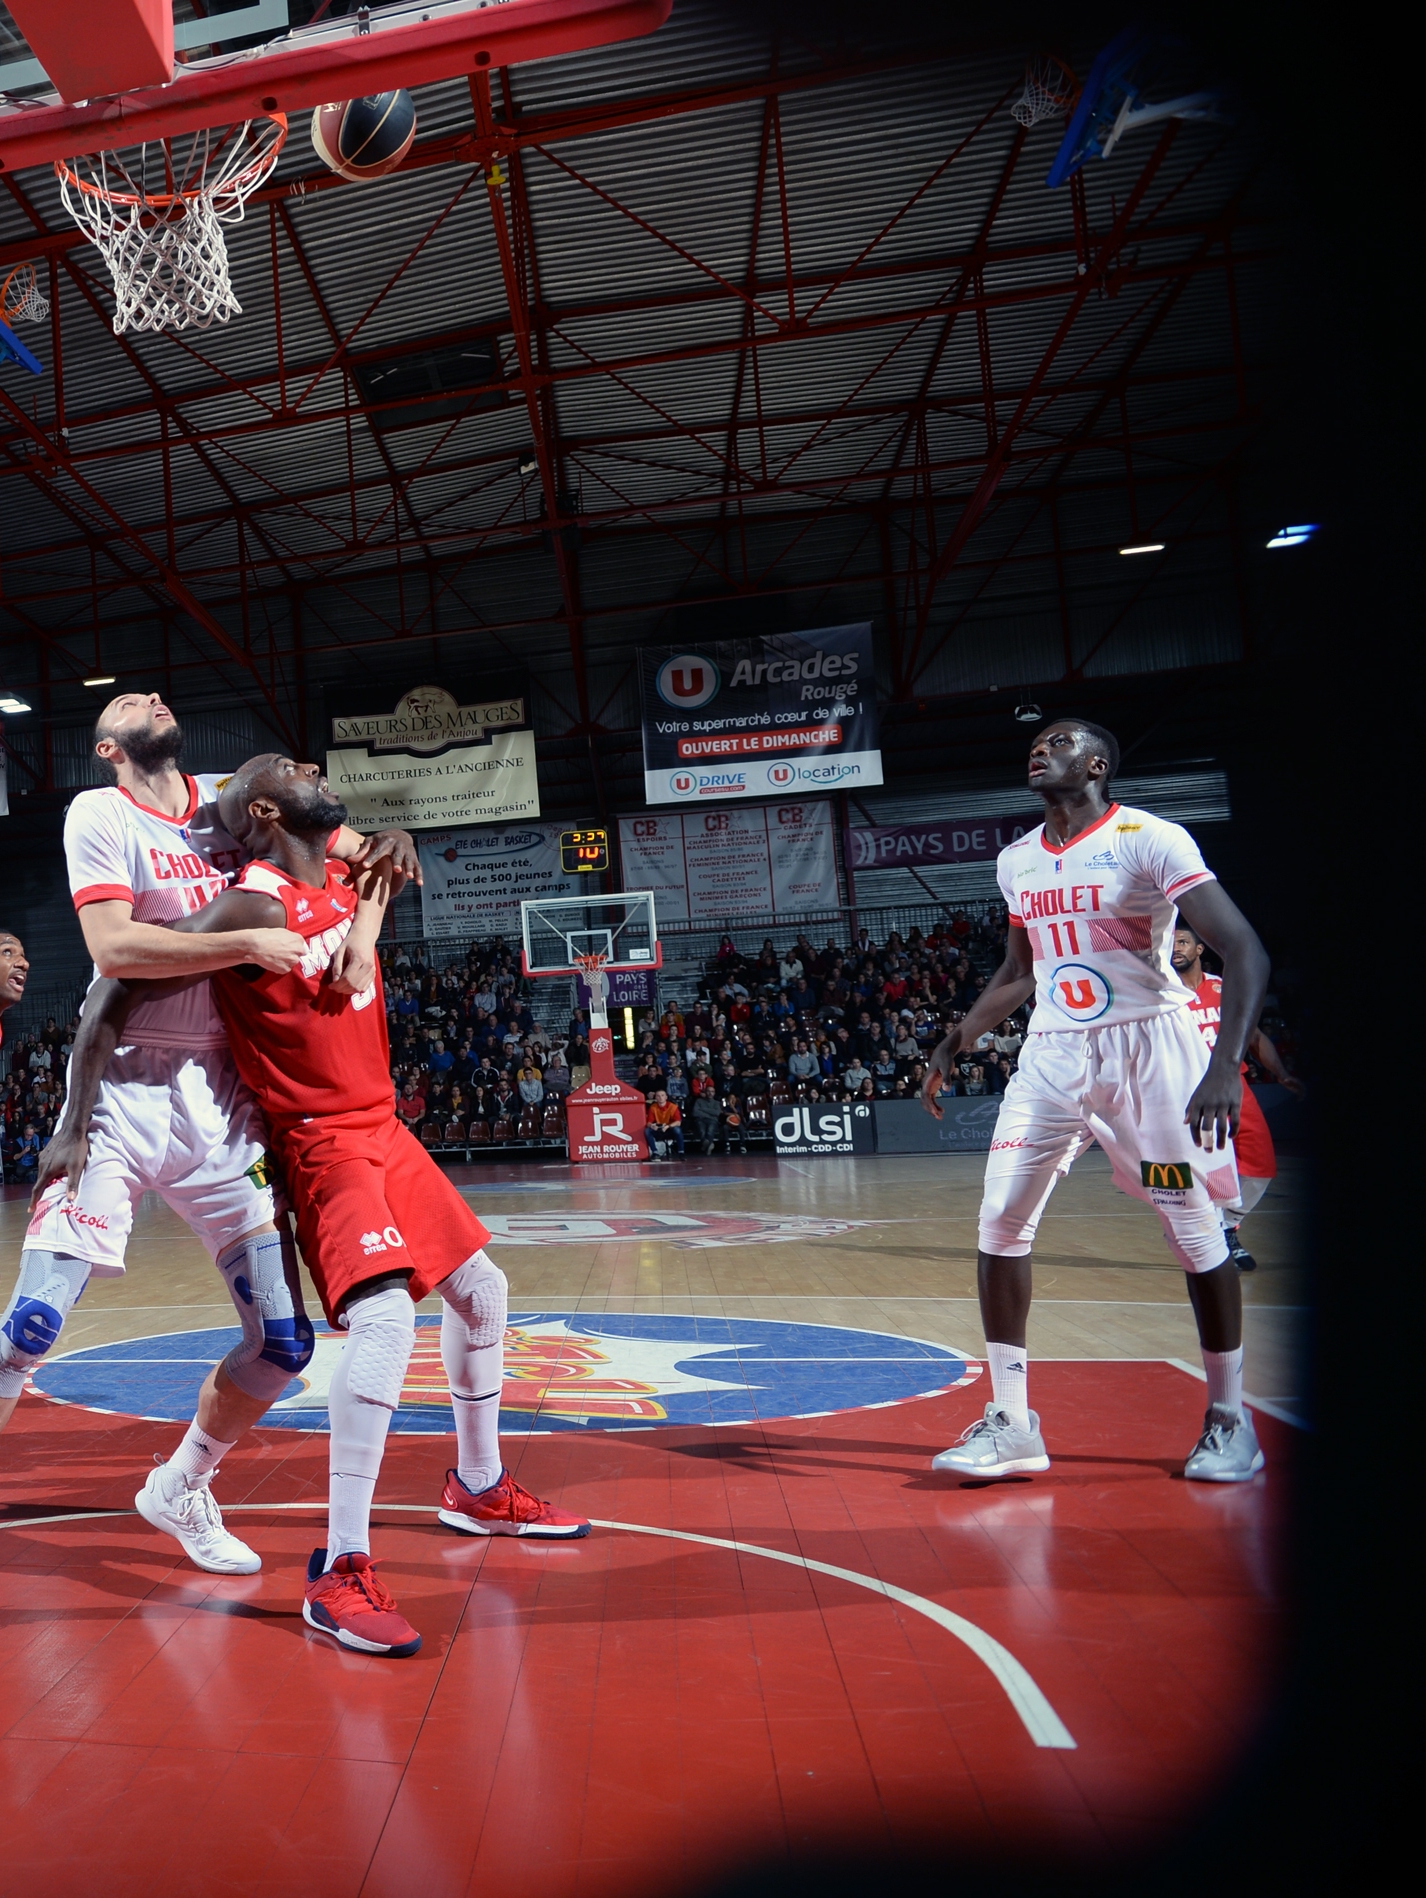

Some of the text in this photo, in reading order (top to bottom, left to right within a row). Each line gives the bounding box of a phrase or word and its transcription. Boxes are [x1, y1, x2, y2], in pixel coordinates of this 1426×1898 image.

[729, 650, 859, 687] Arcades
[801, 680, 857, 701] Rougé
[337, 702, 520, 738] SAVEURS DES MAUGES
[656, 721, 689, 733] Votre
[693, 712, 771, 732] supermarché
[813, 706, 829, 719] de
[833, 704, 854, 716] ville
[379, 728, 478, 745] traditions de l'Anjou
[682, 730, 838, 754] OUVERT LE DIMANCHE
[340, 757, 523, 783] CHARCUTERIES A L'ANCIENNE
[798, 763, 860, 780] location
[699, 773, 746, 786] DRIVE
[381, 795, 405, 807] Aux
[409, 796, 448, 810] rayons
[452, 789, 495, 801] traiteur
[349, 812, 374, 825] libre
[379, 812, 419, 823] service
[424, 811, 437, 819] de
[441, 808, 471, 818] votre
[705, 815, 728, 831] CB
[778, 807, 802, 824] CB
[634, 820, 657, 836] CB
[701, 830, 749, 838] ASSOCIATION
[777, 832, 813, 840] CHAMPION
[420, 835, 451, 845] CAMPS
[505, 834, 532, 846] BASKET
[880, 833, 943, 856] PAYS
[953, 830, 986, 852] DE
[465, 859, 532, 871] Chaque été,
[447, 871, 552, 888] plus de 500 jeunes
[446, 888, 507, 899] retrouvent
[510, 886, 531, 894] aux
[535, 883, 570, 893] camps
[454, 903, 465, 911] Ils
[468, 904, 473, 912] y
[1021, 885, 1104, 920] CHOLET
[1048, 920, 1080, 957] 11
[616, 973, 647, 984] PAYS
[613, 990, 648, 1002] LOIRE
[586, 1083, 620, 1096] Jeep
[774, 1106, 853, 1143] dlsi
[939, 1130, 957, 1140] Le
[578, 1144, 639, 1154] JEAN ROUYER
